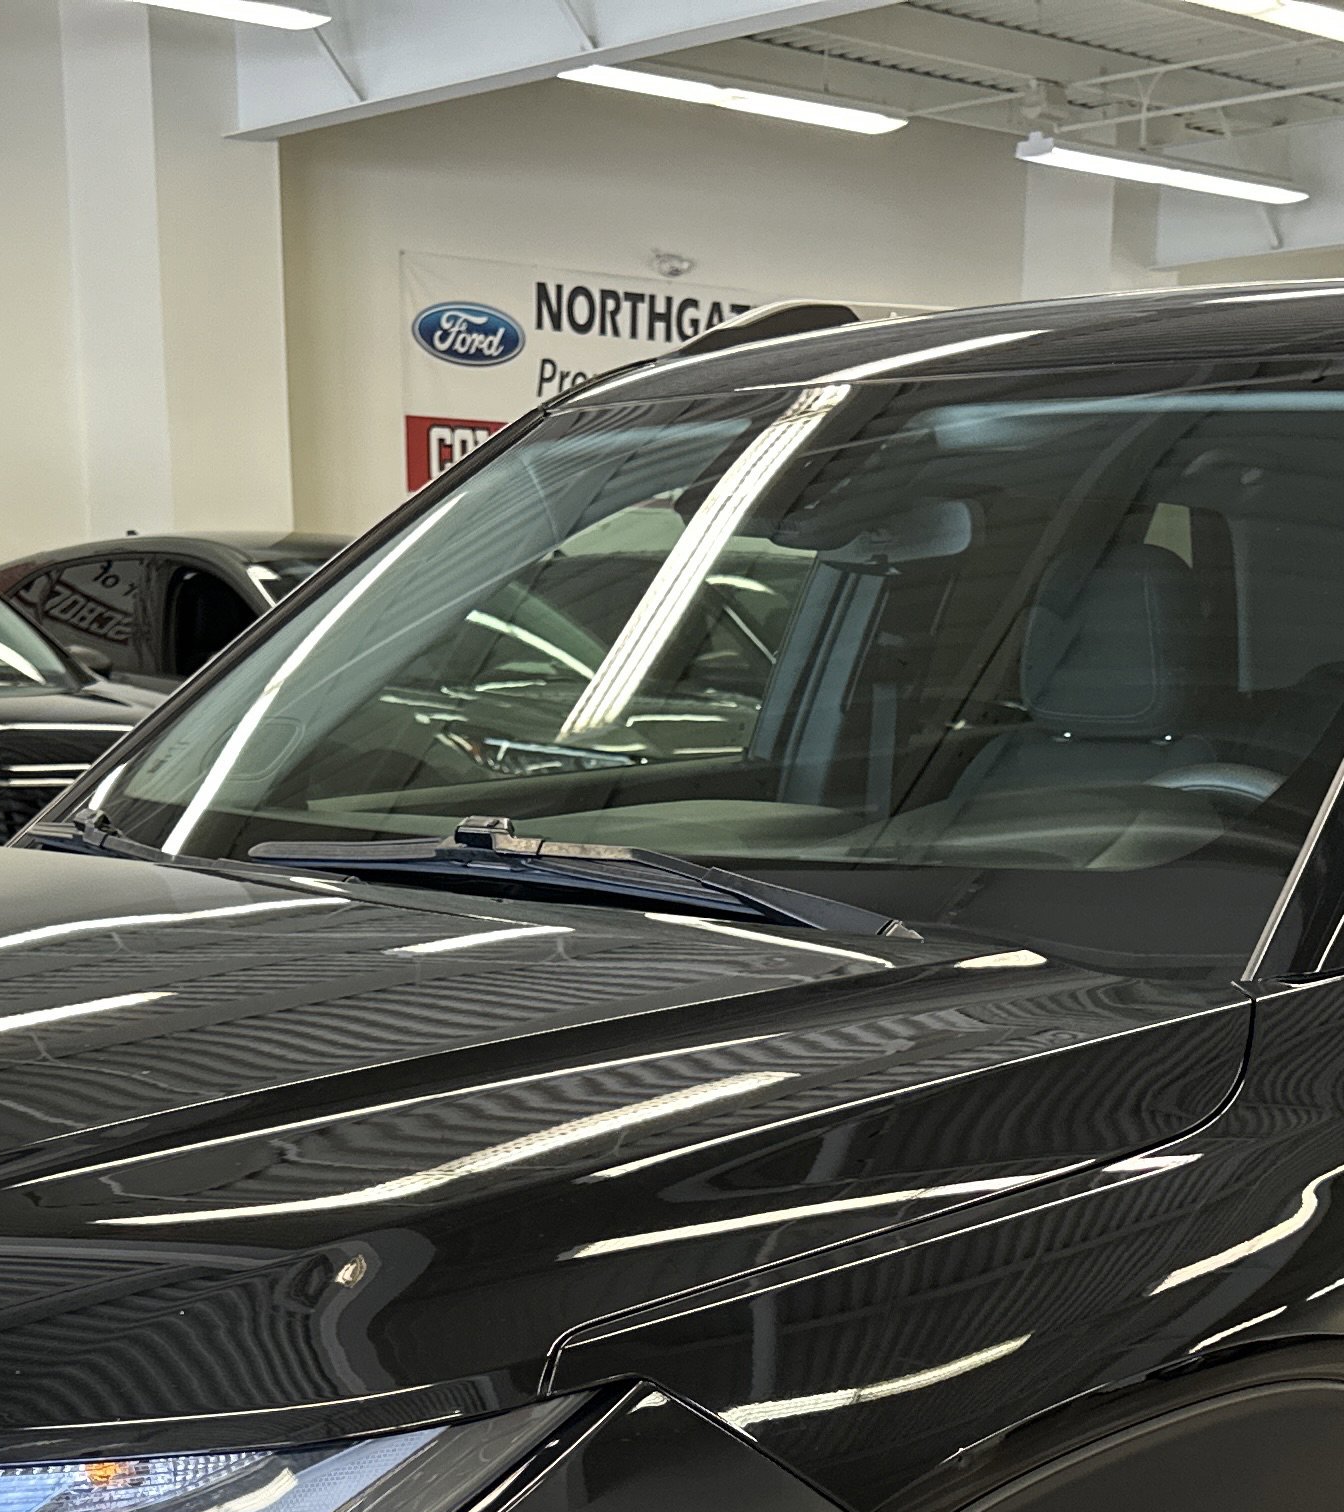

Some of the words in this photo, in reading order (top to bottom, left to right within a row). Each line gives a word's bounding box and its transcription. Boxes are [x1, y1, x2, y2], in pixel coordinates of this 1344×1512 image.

[433, 310, 504, 357] Ford
[535, 281, 752, 343] NORTHGA
[537, 358, 587, 397] Pro
